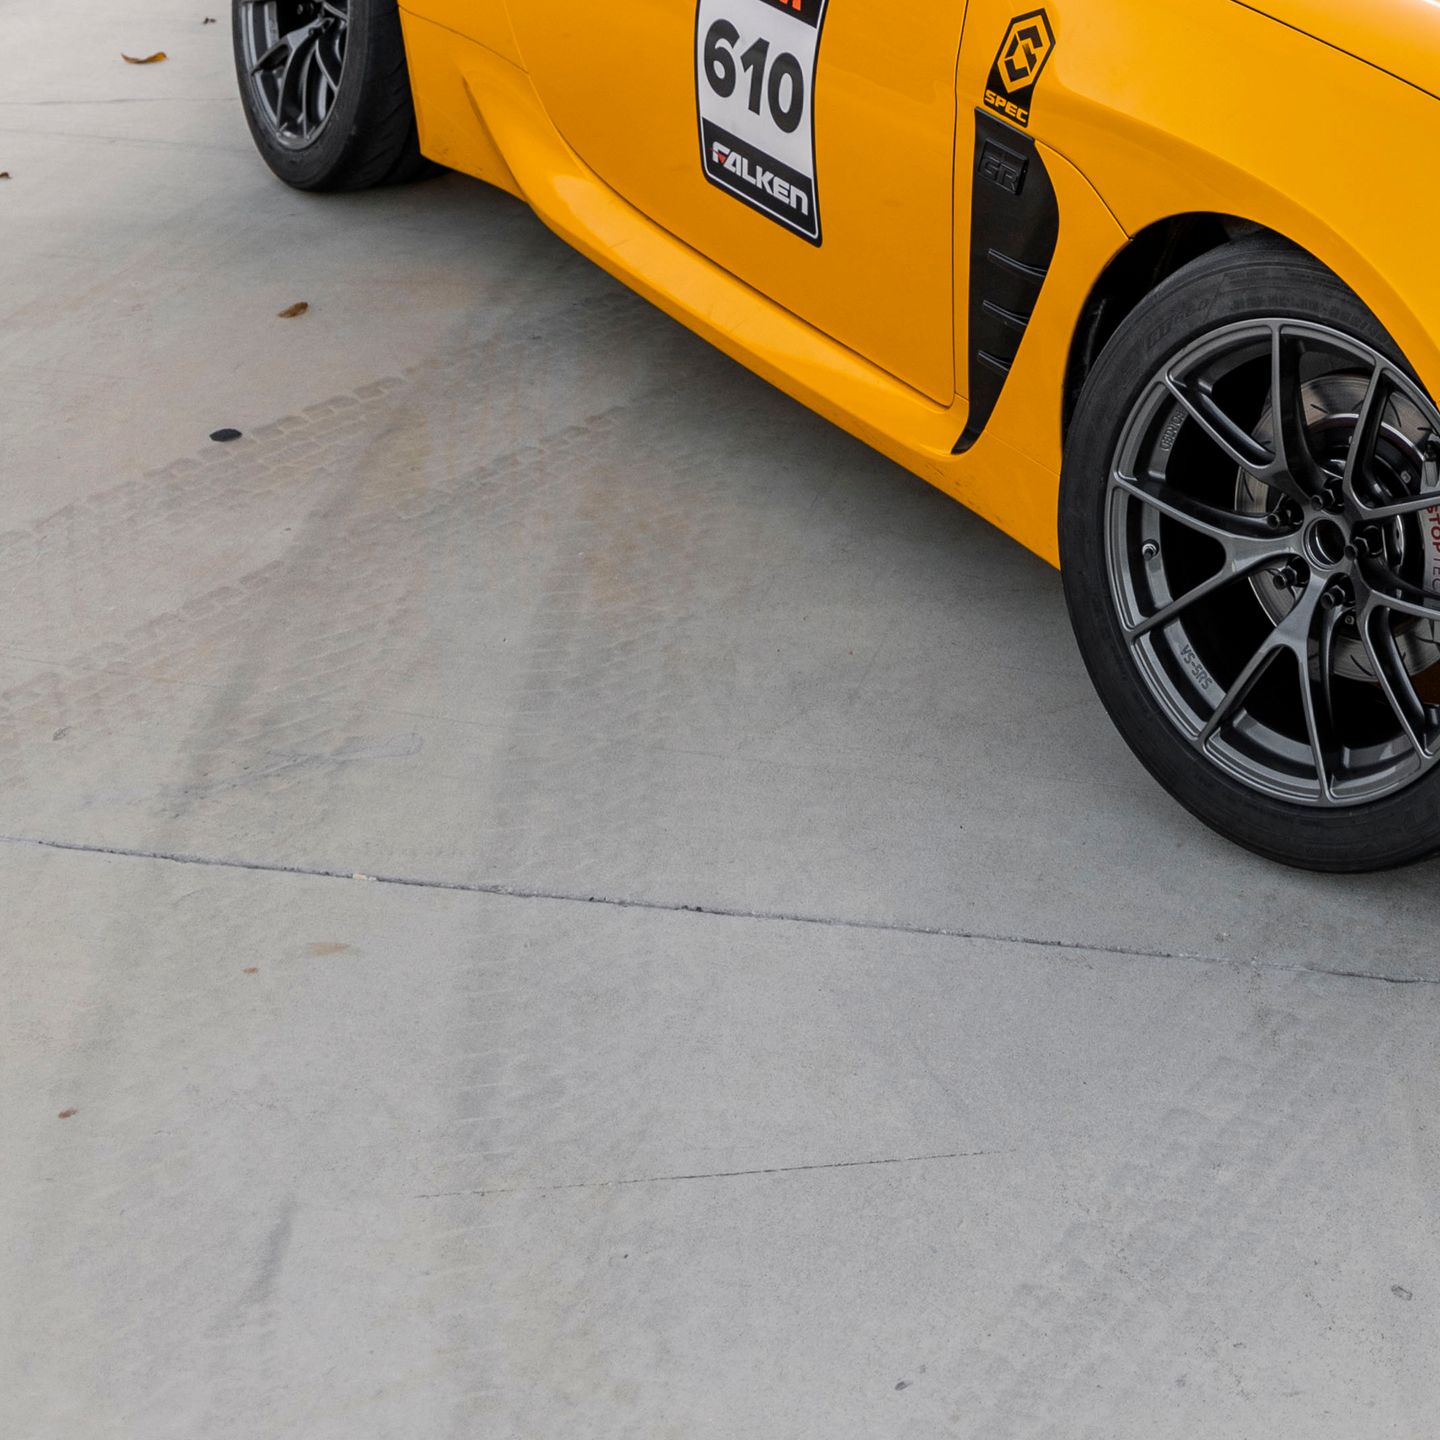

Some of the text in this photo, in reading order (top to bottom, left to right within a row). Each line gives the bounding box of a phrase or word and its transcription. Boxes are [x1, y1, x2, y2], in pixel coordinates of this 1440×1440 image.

[704, 19, 804, 133] 610
[984, 88, 1028, 123] SPEC
[711, 140, 809, 216] FALKEN
[1180, 643, 1213, 690] VS-5RS
